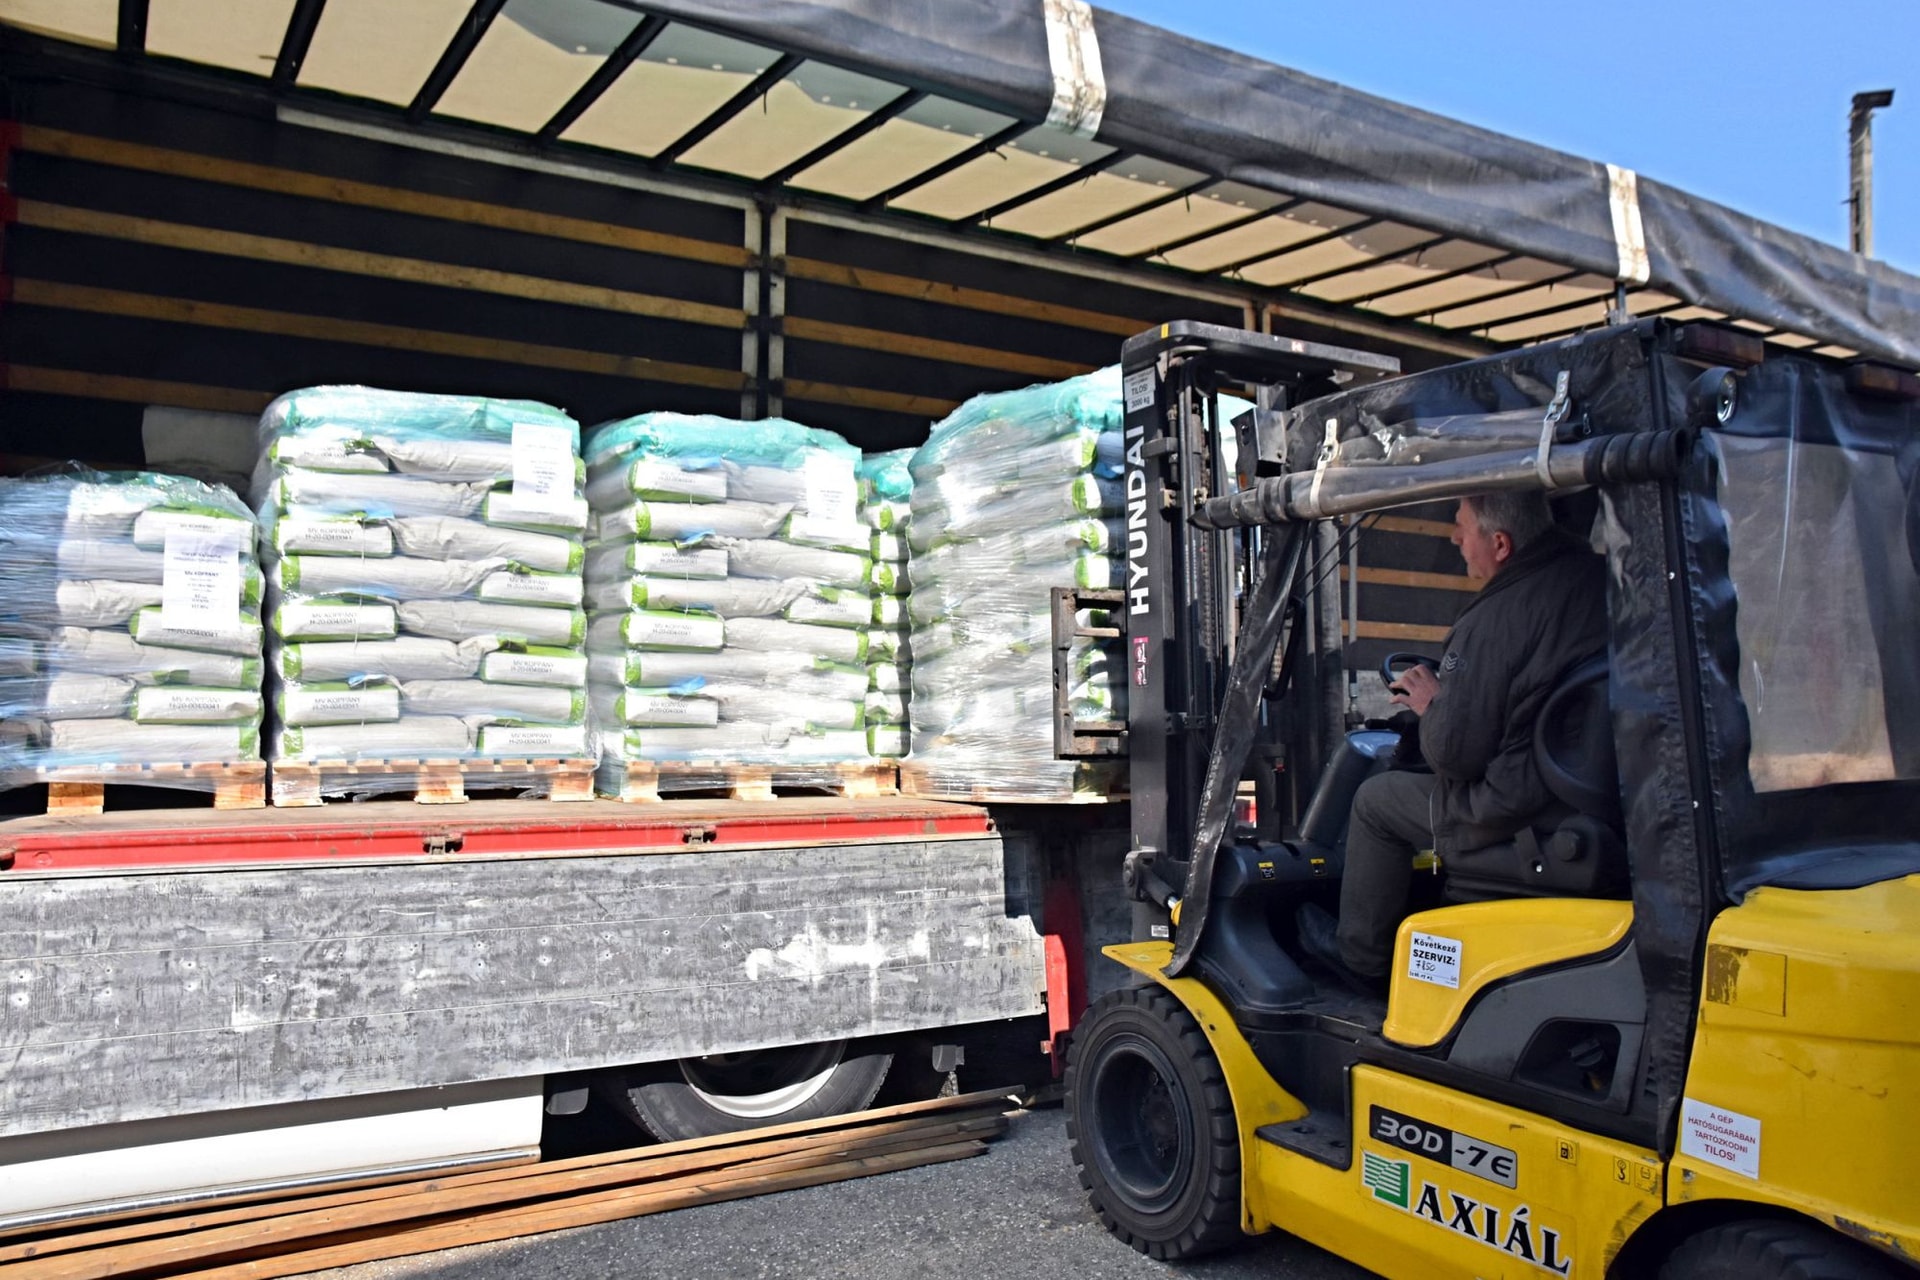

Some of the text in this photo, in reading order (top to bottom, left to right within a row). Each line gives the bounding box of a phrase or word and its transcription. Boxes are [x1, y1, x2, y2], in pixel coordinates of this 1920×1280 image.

[1126, 425, 1149, 615] HYUNDAI
[1413, 937, 1457, 953] Következő
[1413, 948, 1456, 966] SZERVIZ:
[1688, 1116, 1756, 1144] HATÓSUGARÁBAN
[1694, 1129, 1748, 1154] TARTÓZKODNI
[1704, 1143, 1736, 1162] TILOS!
[1415, 1183, 1571, 1275] AXIÁL
